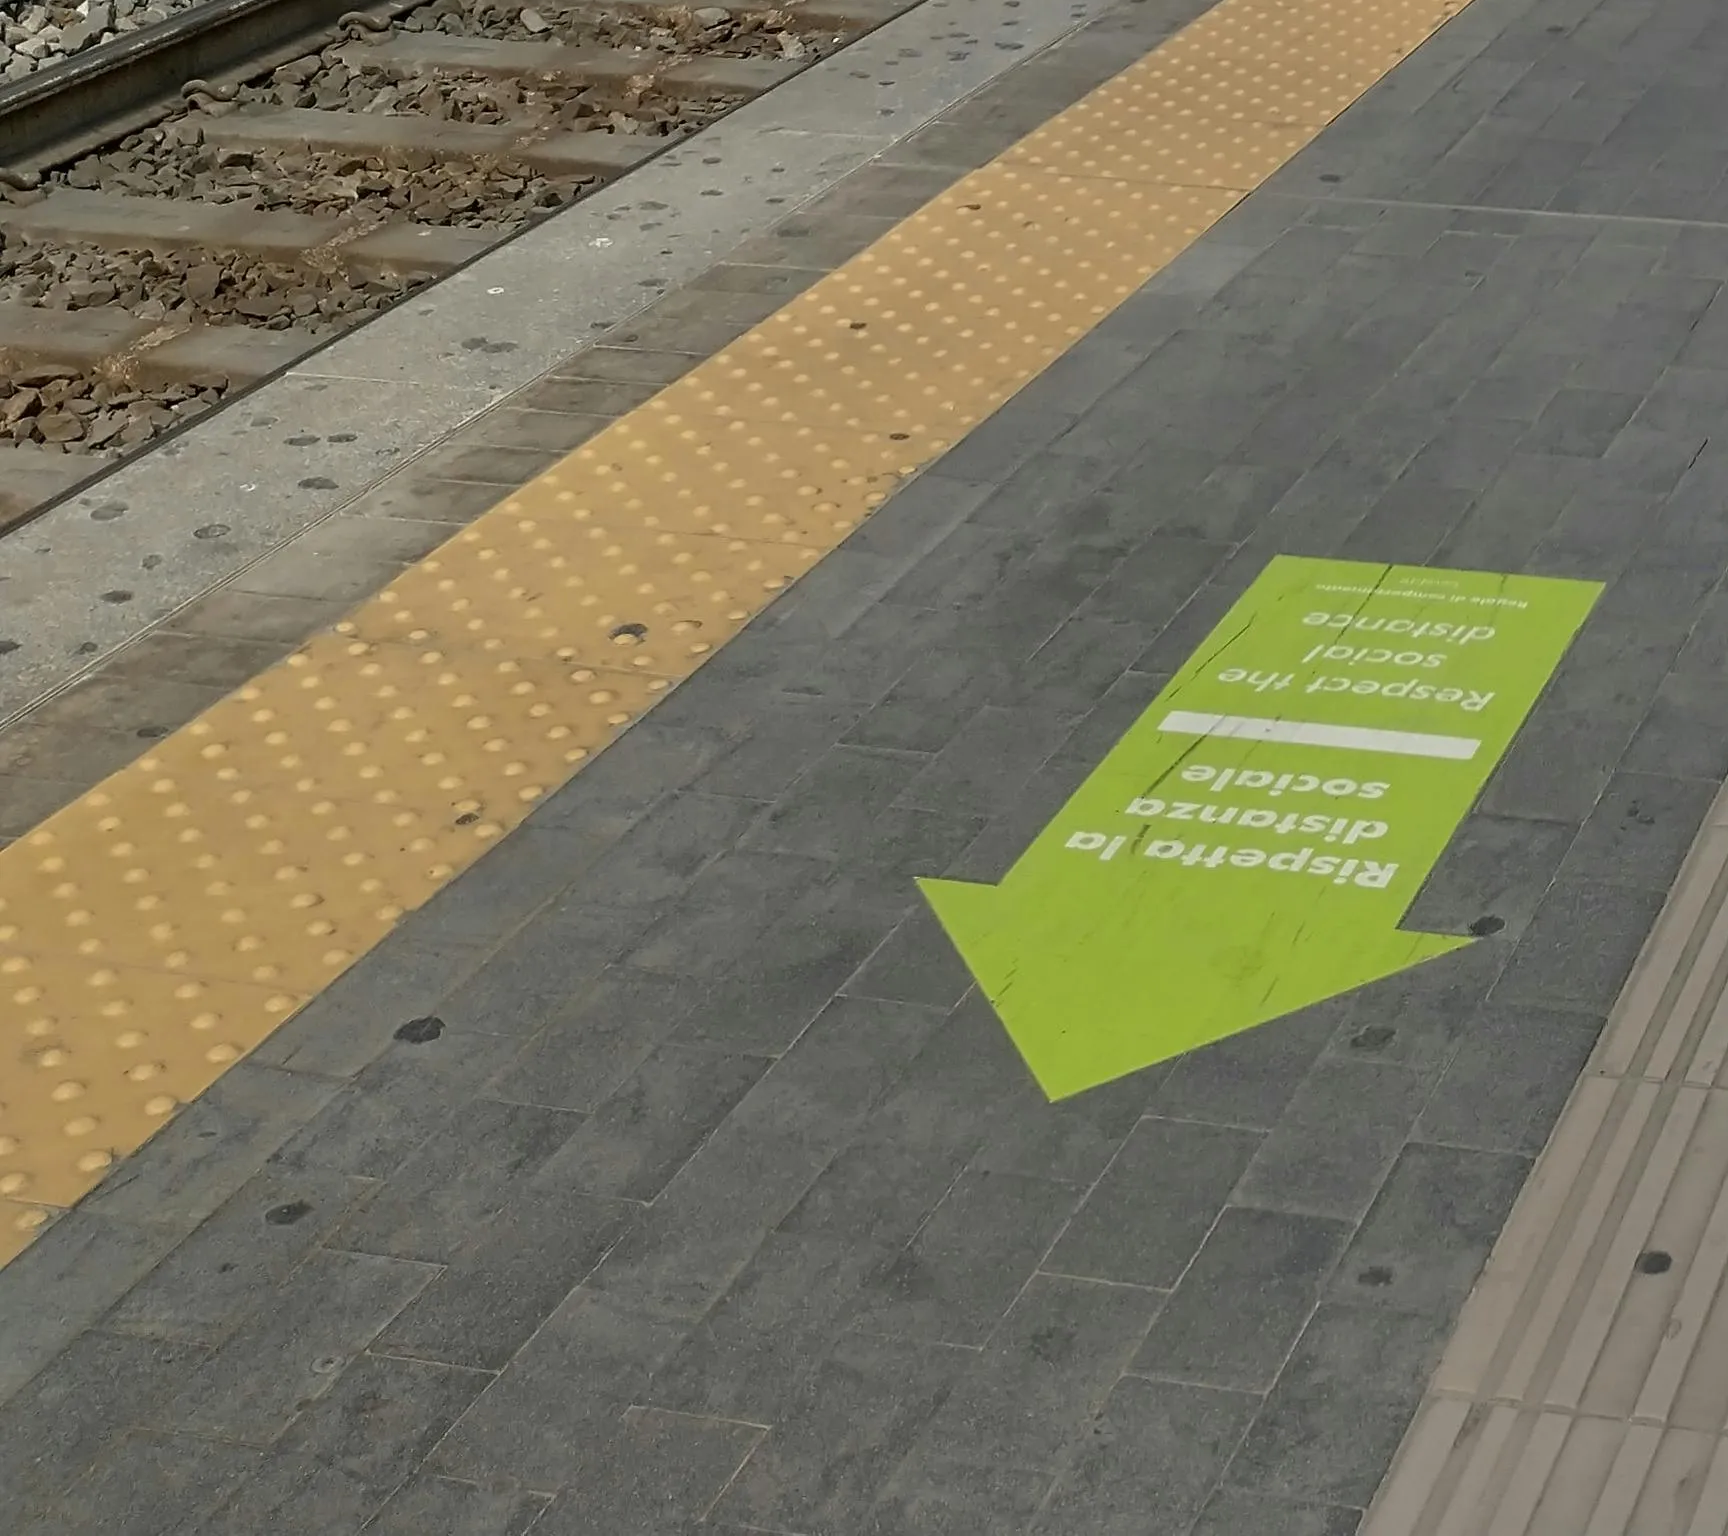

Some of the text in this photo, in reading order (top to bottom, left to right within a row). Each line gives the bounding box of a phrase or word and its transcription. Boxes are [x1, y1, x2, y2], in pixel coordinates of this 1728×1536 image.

[1302, 610, 1496, 645] distance
[1302, 643, 1448, 670] social
[1217, 667, 1496, 712] Respect the
[1180, 763, 1391, 800] sociale
[1124, 796, 1389, 845] distanza
[1064, 831, 1400, 889] Rispetta la
